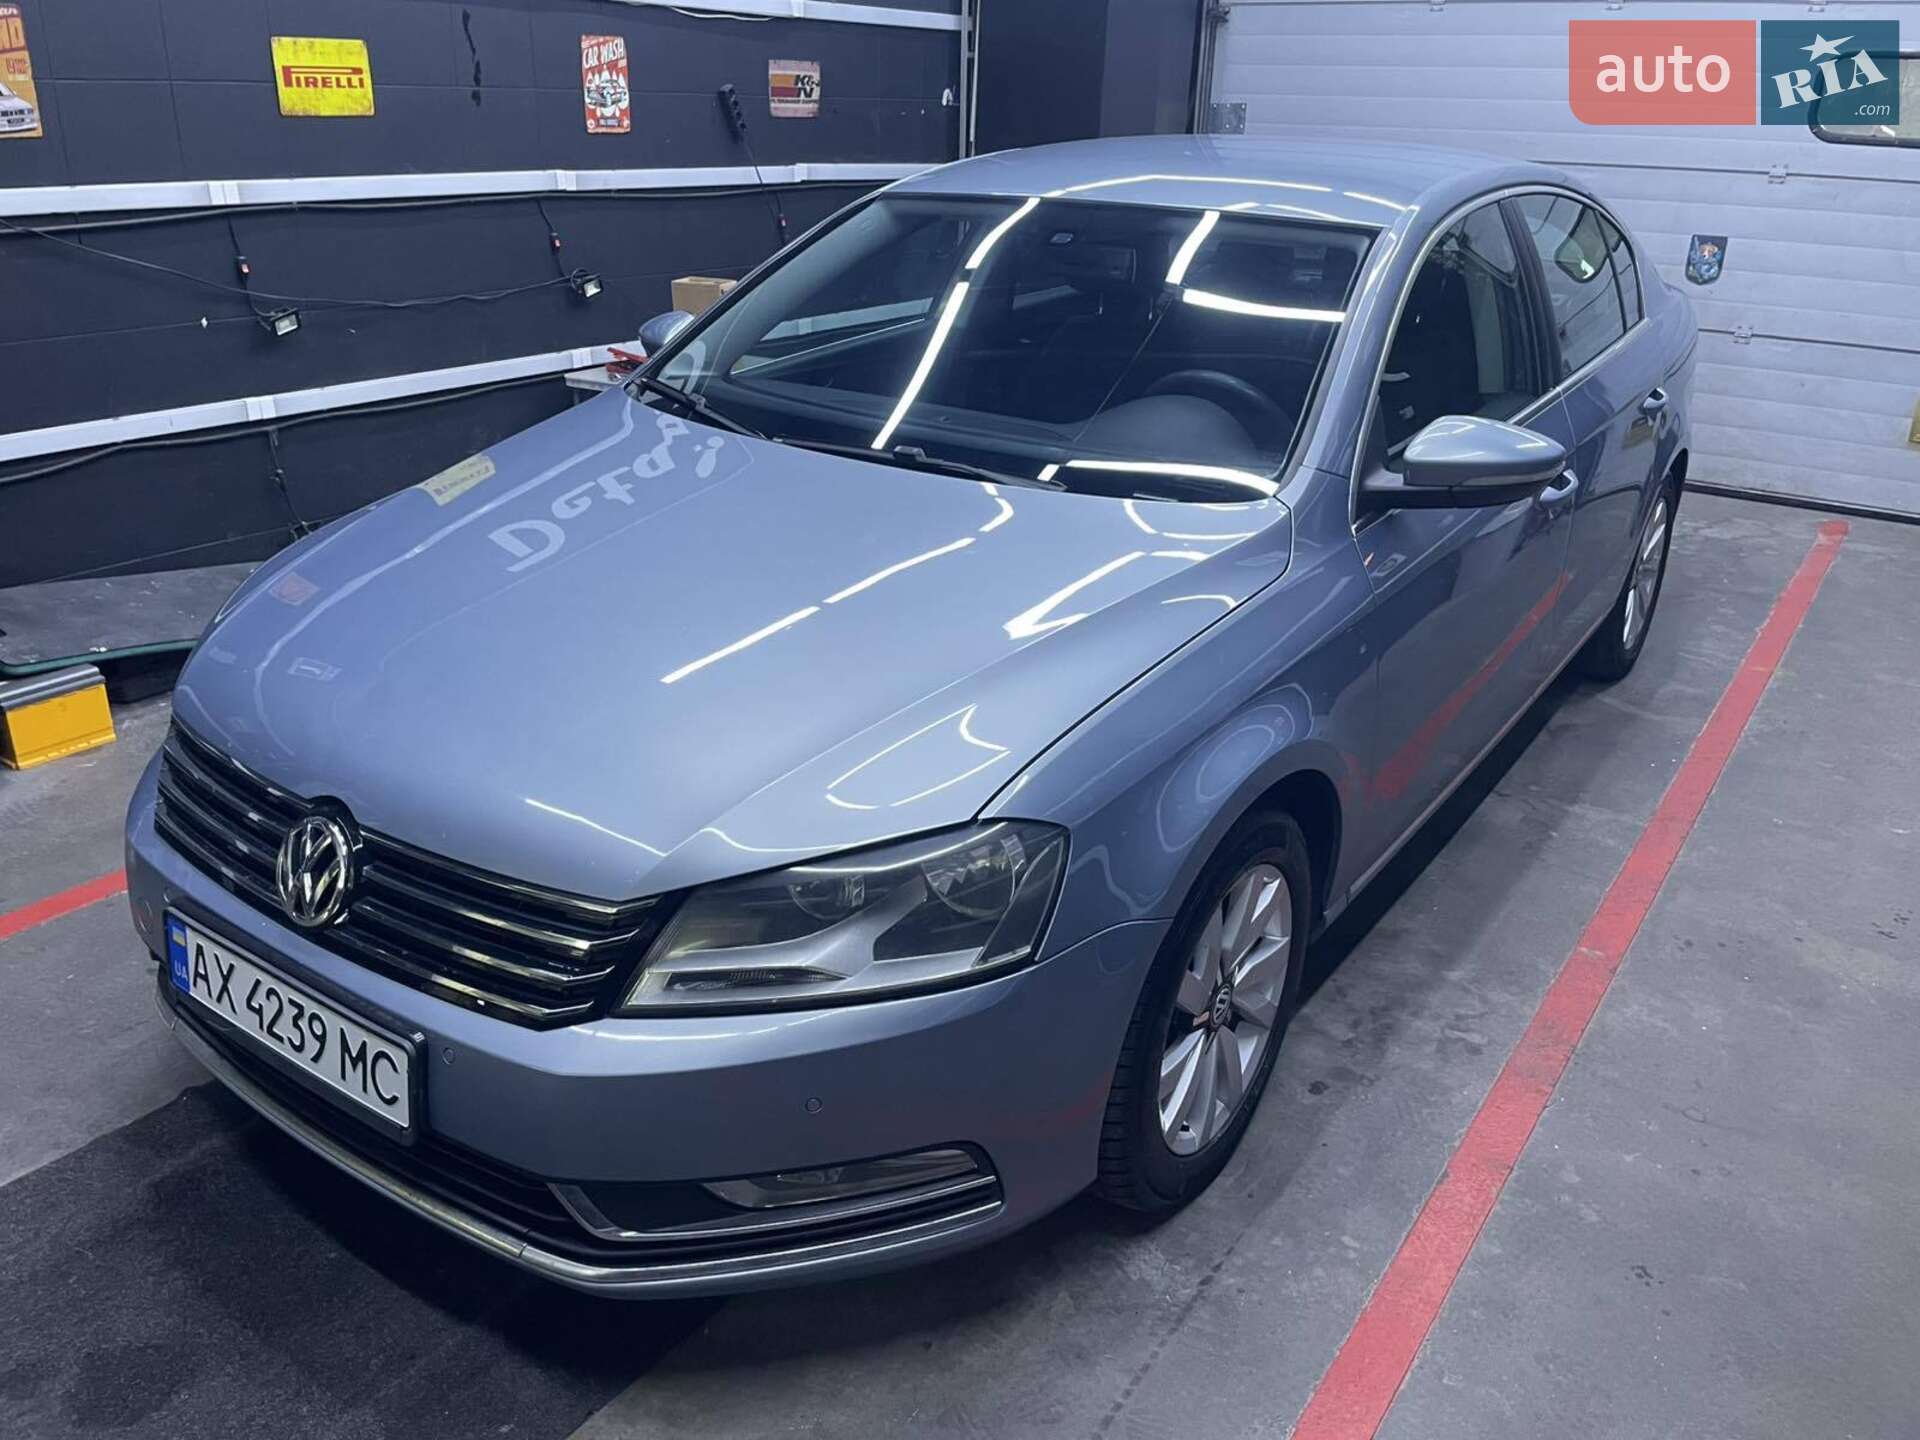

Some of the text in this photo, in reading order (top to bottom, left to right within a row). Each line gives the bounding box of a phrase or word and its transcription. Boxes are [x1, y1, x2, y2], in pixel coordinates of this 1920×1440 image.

[583, 36, 625, 69] CAR WASH
[281, 65, 365, 88] PIRELLI
[174, 961, 188, 980] UA
[193, 942, 400, 1106] AX 4239 MC
